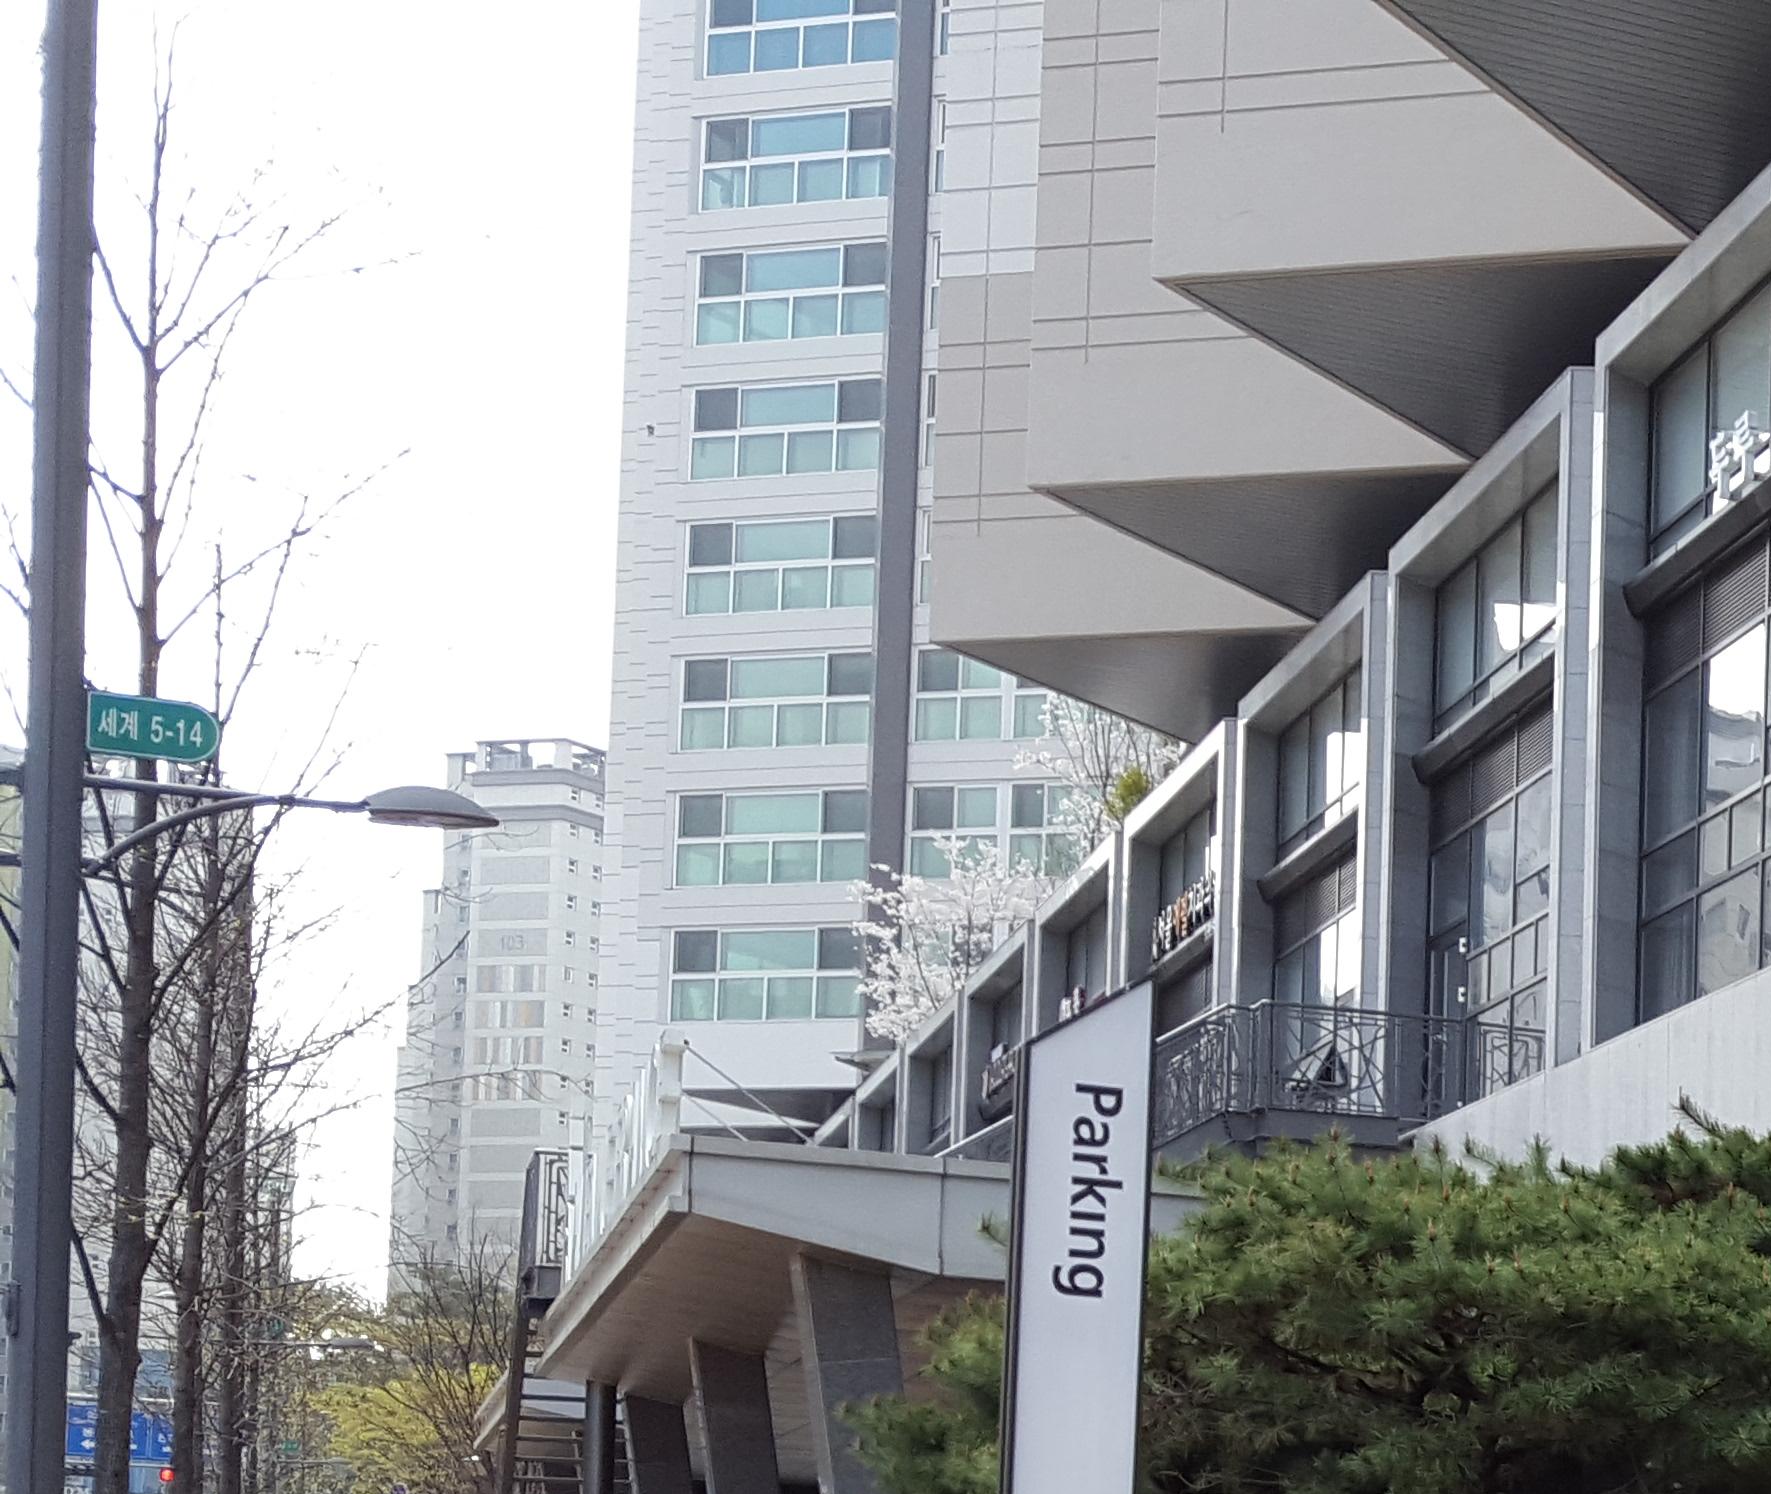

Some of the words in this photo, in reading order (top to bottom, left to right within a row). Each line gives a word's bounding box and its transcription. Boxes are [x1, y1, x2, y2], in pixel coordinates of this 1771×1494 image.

[98, 707, 138, 741] 세계
[150, 715, 203, 748] 5-14
[1052, 1082, 1124, 1299] Parking
